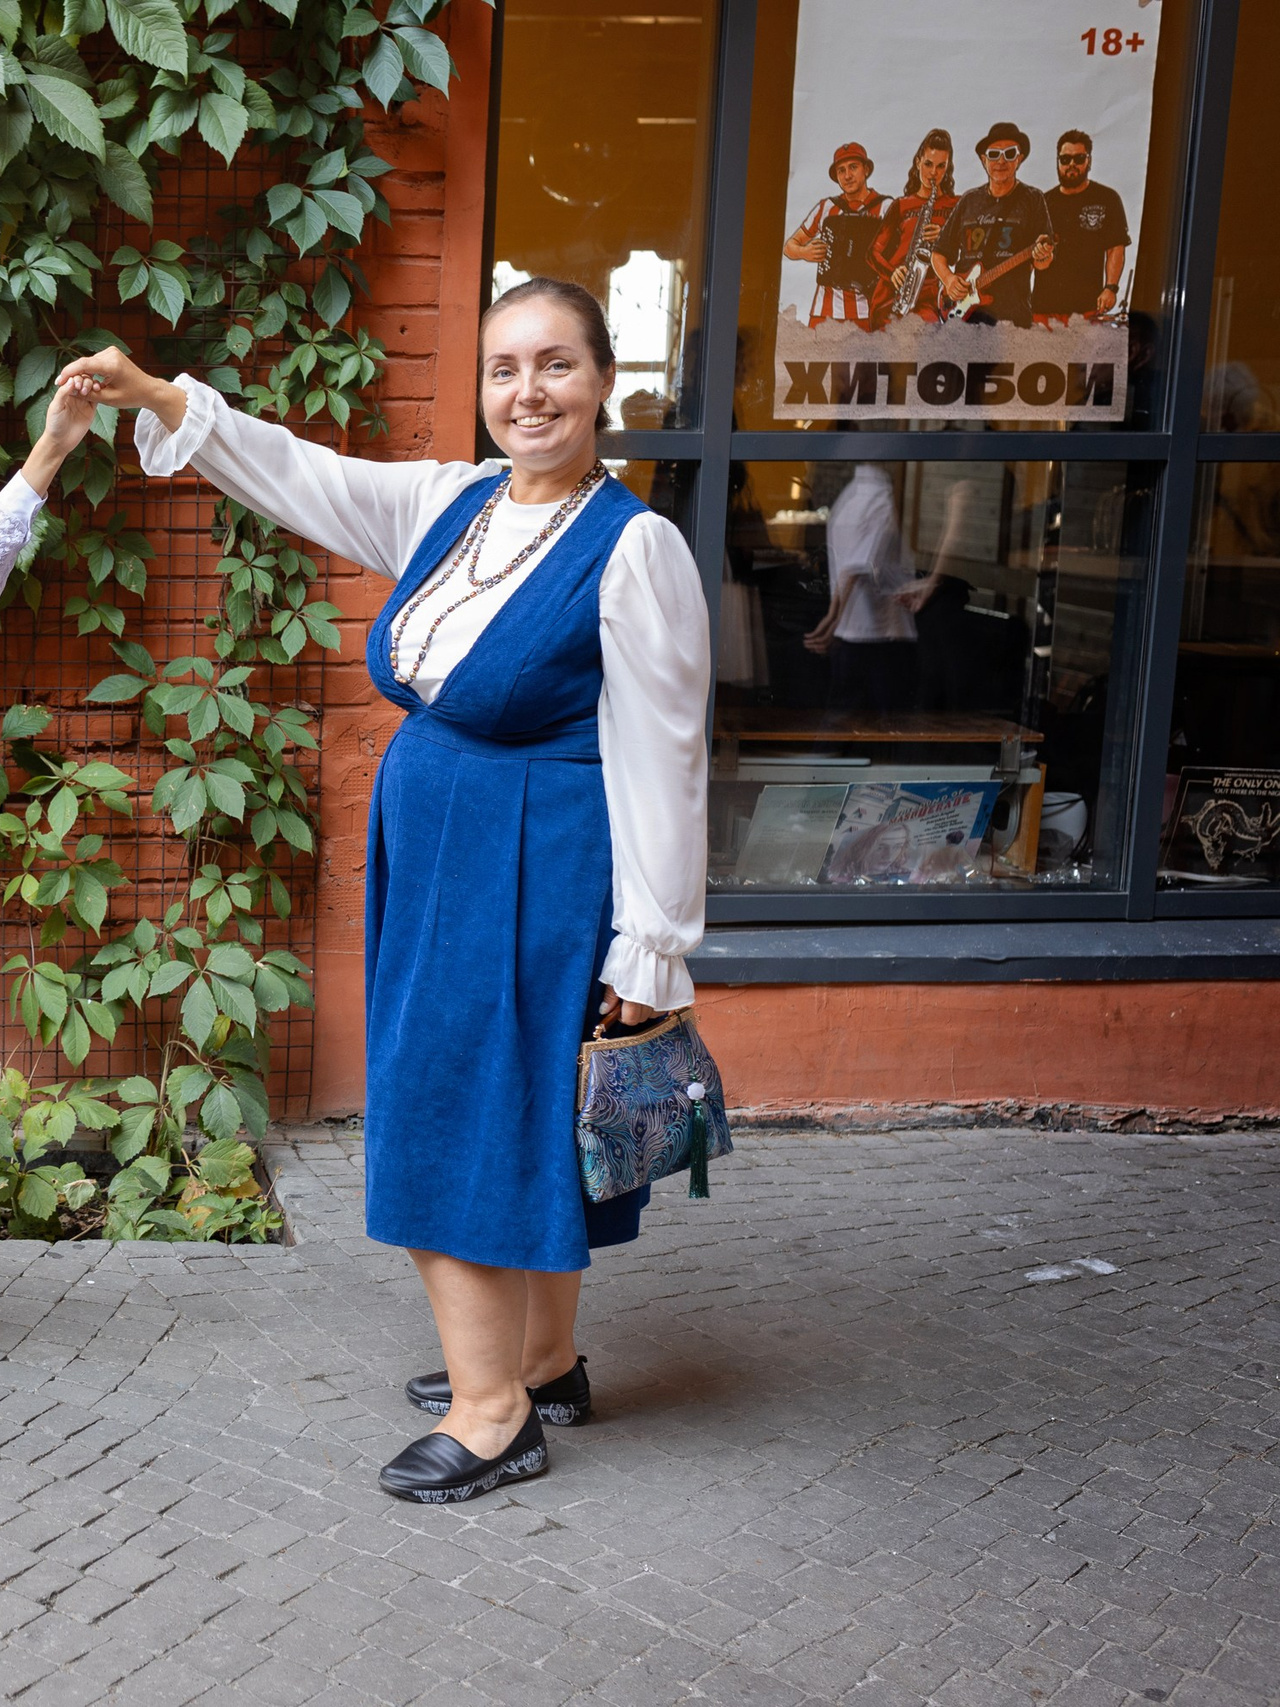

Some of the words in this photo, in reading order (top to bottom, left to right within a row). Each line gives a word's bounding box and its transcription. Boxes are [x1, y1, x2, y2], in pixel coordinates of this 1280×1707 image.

[1081, 27, 1145, 56] 18+
[1213, 777, 1232, 787] THE
[1233, 778, 1263, 788] ONLY
